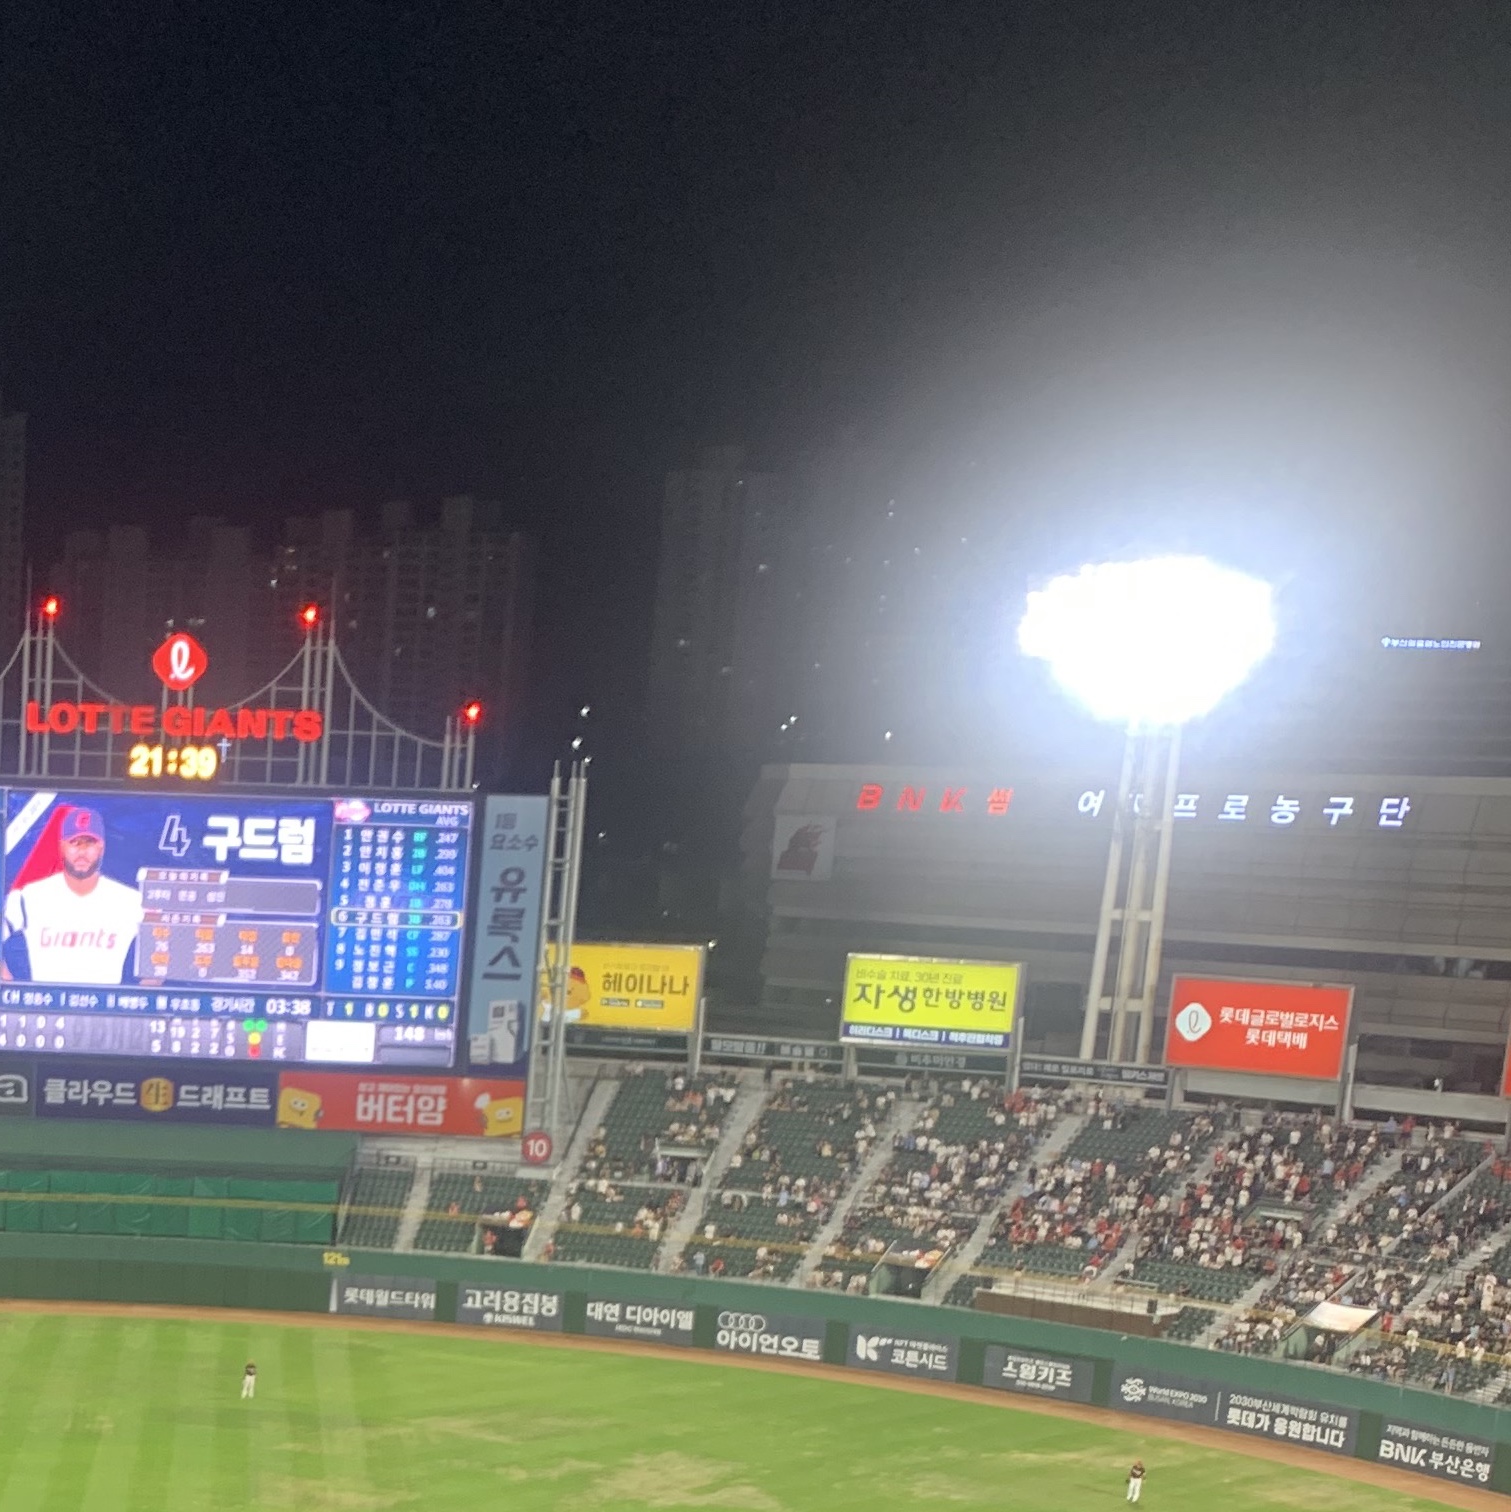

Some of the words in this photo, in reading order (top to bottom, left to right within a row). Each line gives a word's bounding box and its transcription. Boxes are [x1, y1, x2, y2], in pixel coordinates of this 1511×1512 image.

[26, 701, 155, 734] LOTTE
[162, 706, 323, 742] GIANTS
[374, 803, 416, 814] LOTTE
[418, 804, 469, 815] GIANTS
[202, 816, 316, 864] 구드럼
[489, 833, 539, 852] 요소수
[482, 866, 526, 980] 유록스
[39, 927, 118, 951] Giants
[602, 972, 689, 996] 헤이나나
[853, 982, 1007, 1013] 자생한방병원
[266, 1000, 312, 1015] 03:38
[1219, 1006, 1339, 1031] 롯데글로벌로지스
[1244, 1028, 1308, 1049] 롯데택배
[44, 1079, 137, 1105] 클라우드
[177, 1083, 271, 1111] 드래프트
[526, 1139, 546, 1157] 10
[344, 1287, 436, 1310] 롯데월드타워
[463, 1289, 558, 1317] 고려용접봉
[587, 1302, 620, 1322] 대연
[626, 1305, 694, 1331] 디아이엘
[717, 1329, 822, 1360] 아이언오토
[1002, 1361, 1072, 1388] 스윙키즈
[1227, 1407, 1271, 1431] 롯데가
[1274, 1417, 1346, 1448] 응원합니다
[1379, 1439, 1427, 1467] BNK
[1429, 1450, 1491, 1482] 부산은행
